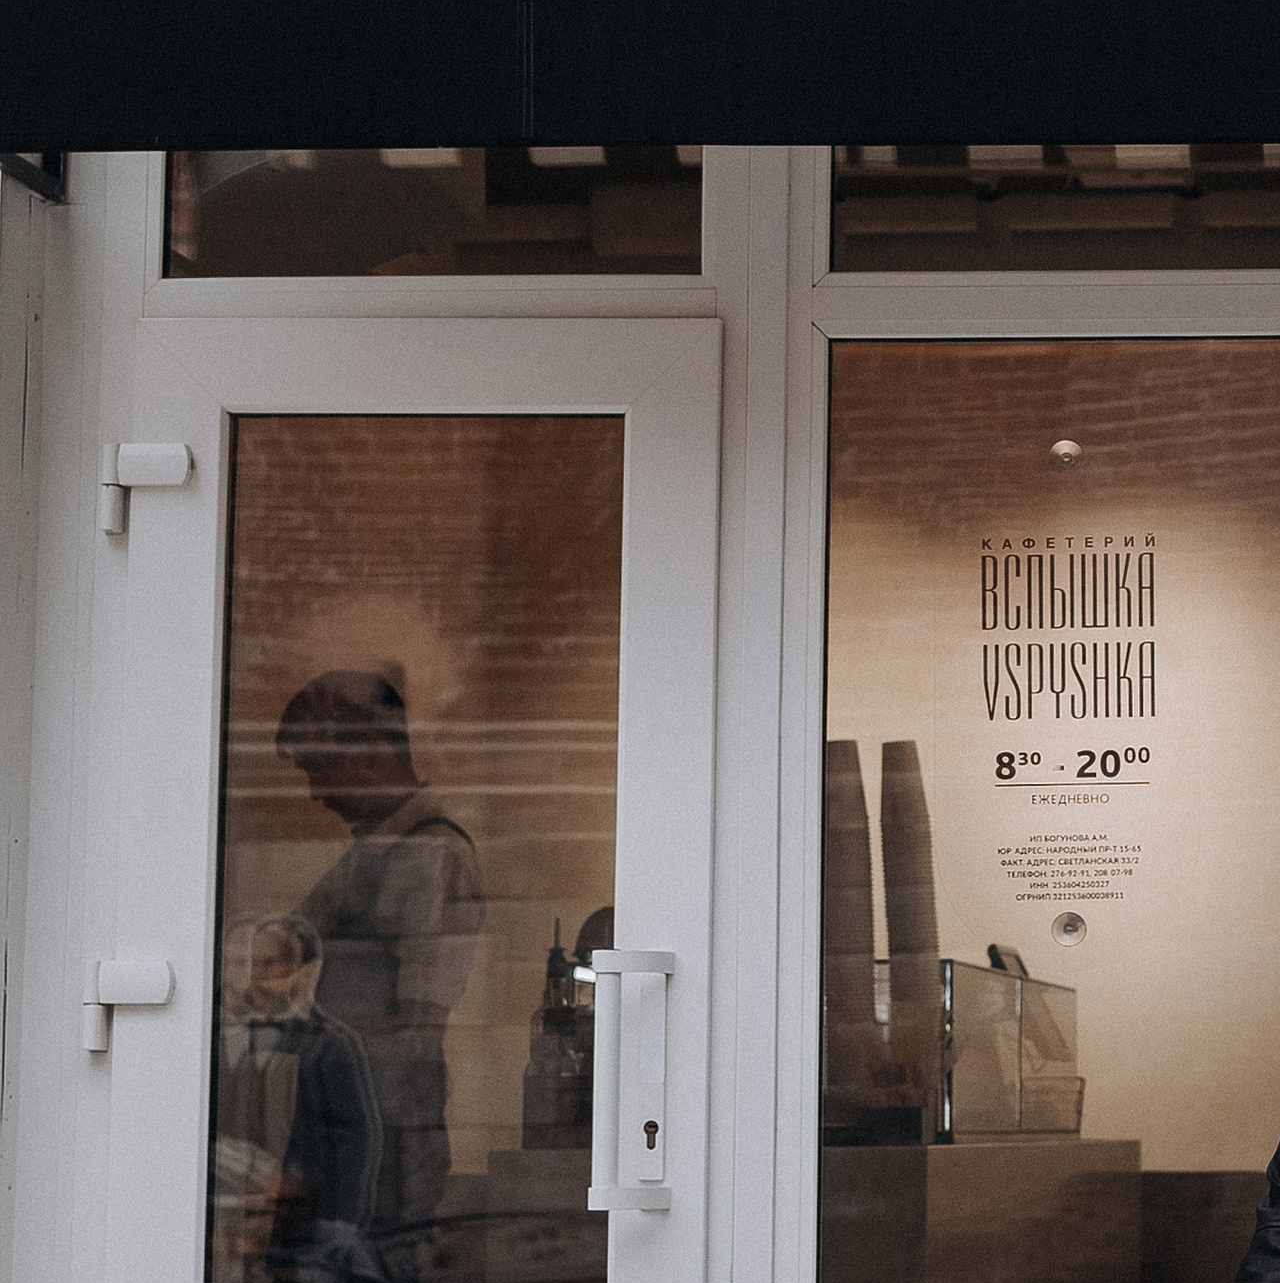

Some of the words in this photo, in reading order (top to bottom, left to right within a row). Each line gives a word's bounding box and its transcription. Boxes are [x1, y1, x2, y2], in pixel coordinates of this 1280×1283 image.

[981, 532, 1156, 550] КАФЕТЕРИЙ
[981, 552, 1155, 631] ВСПЫШКА
[982, 641, 1156, 721] VSPYSHKA
[1031, 793, 1110, 806] ЕЖЕДНЕВНО
[1029, 835, 1043, 843] ИП
[1044, 834, 1090, 842] БОГУНОВА
[1046, 845, 1097, 854] НАРОДНЫЙ
[1058, 857, 1119, 866] СВЕТЛАНСКАЯ
